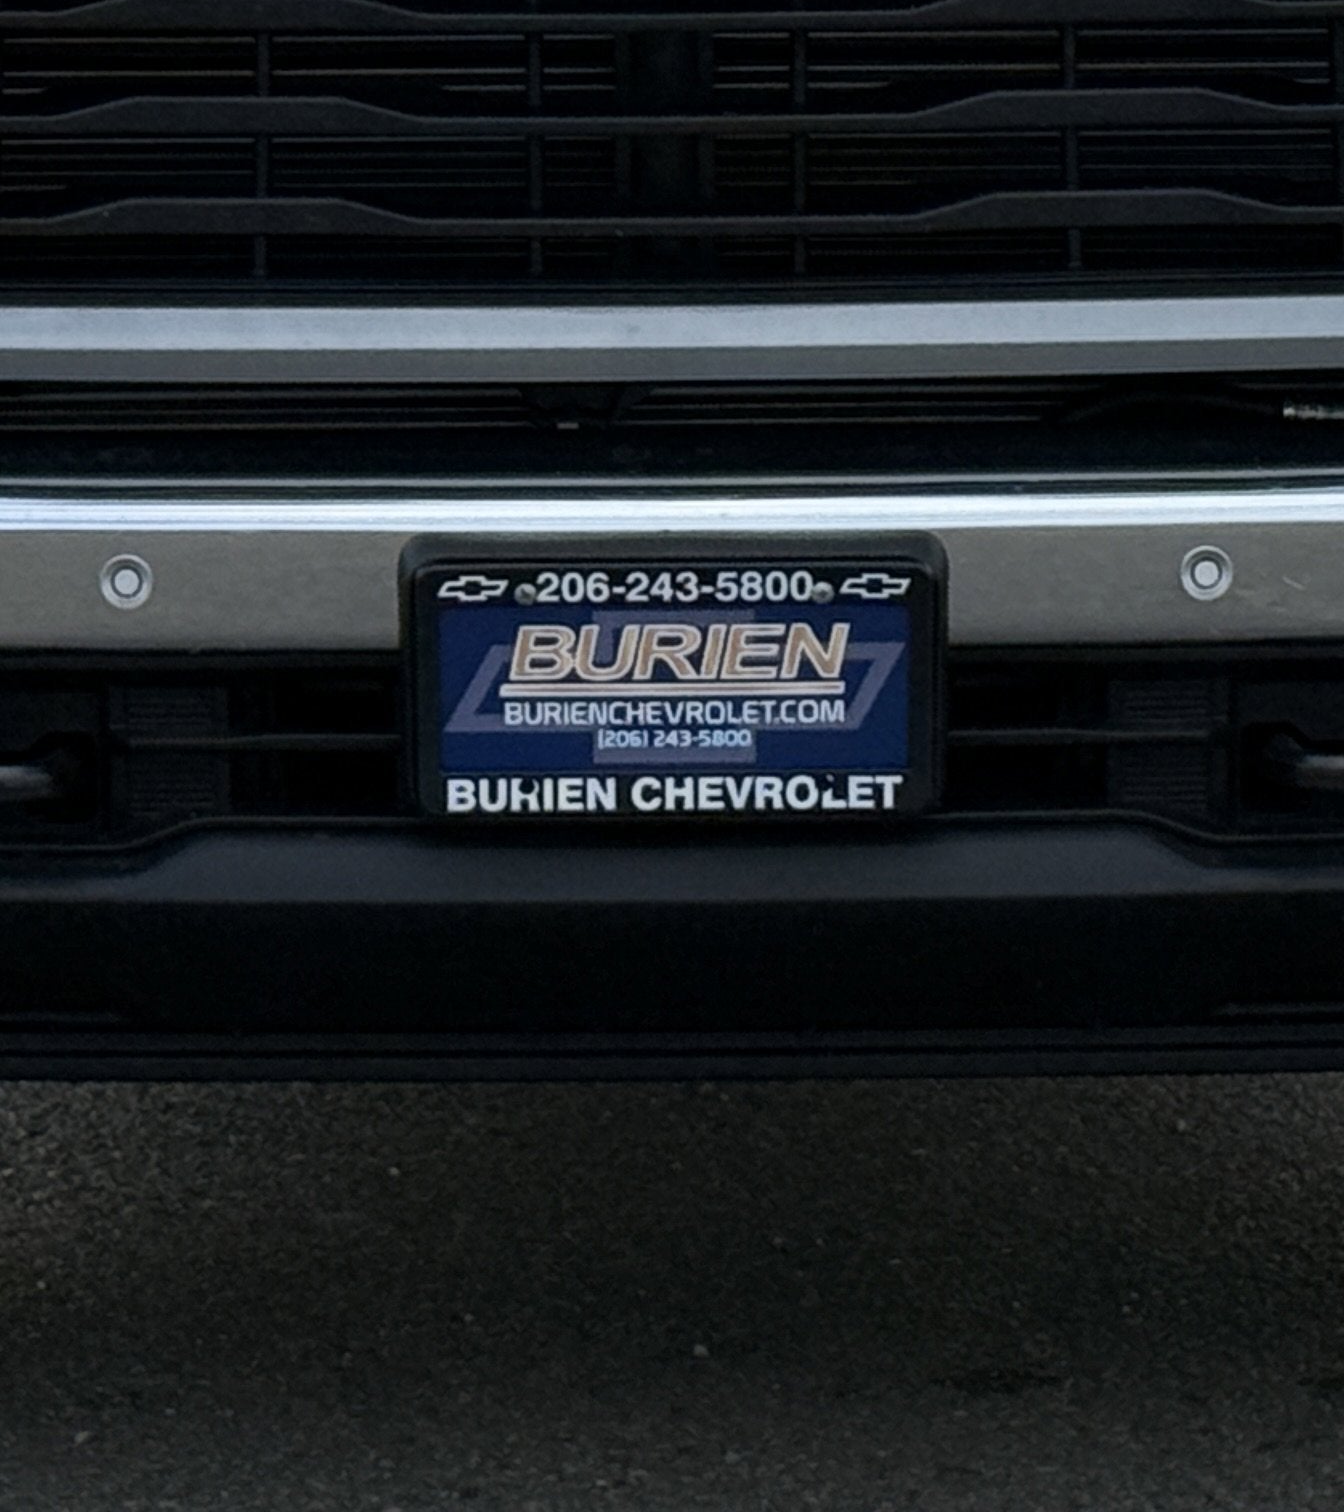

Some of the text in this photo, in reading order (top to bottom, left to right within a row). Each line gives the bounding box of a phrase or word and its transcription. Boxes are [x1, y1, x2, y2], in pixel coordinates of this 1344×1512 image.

[535, 571, 815, 603] 206-243-5800
[508, 622, 851, 682] BURIEN
[503, 699, 846, 726] BURIENCHEVROLET.COM
[653, 728, 753, 749] 243-5800
[446, 774, 904, 812] BURIEN CHEVROLET
